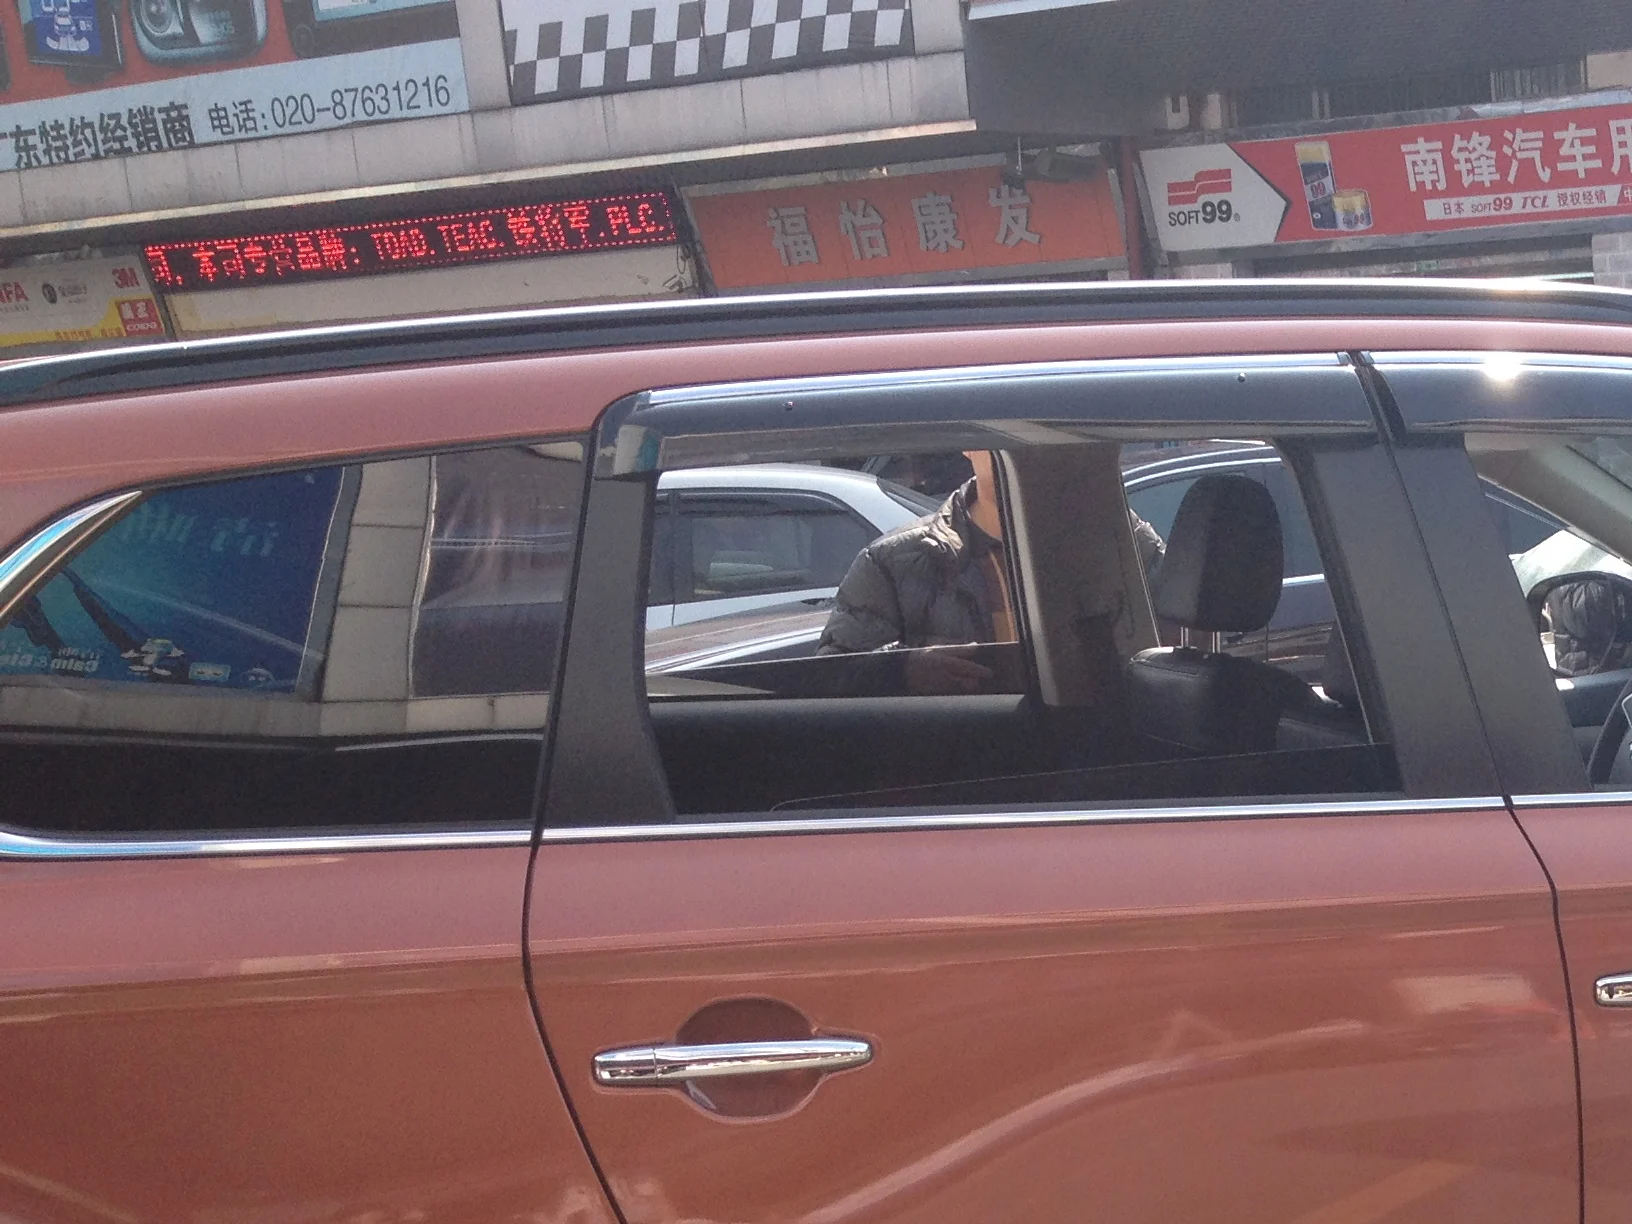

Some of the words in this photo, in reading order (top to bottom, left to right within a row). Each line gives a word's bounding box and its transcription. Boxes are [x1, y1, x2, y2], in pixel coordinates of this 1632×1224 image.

[1168, 199, 1233, 227] SOFT99
[1442, 201, 1464, 215] 日本
[1471, 197, 1514, 213] SOFT99
[1521, 195, 1550, 209] TCL
[767, 184, 1041, 266] 福怡康发
